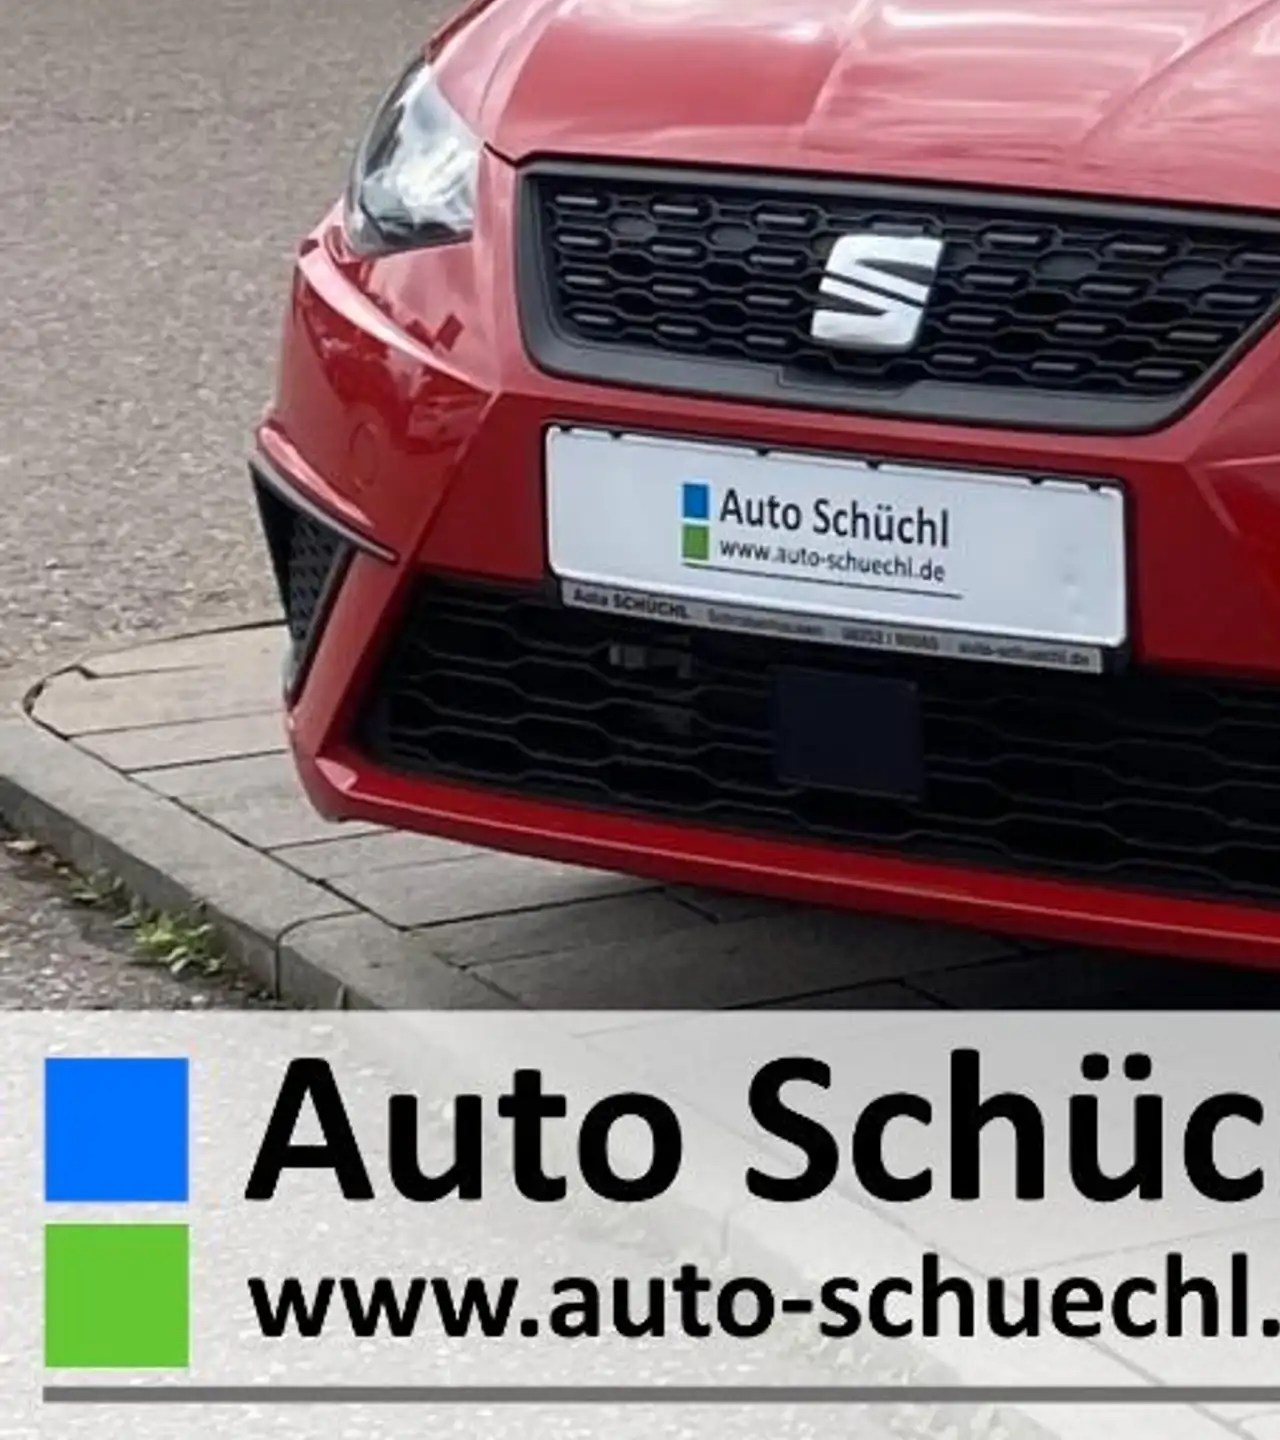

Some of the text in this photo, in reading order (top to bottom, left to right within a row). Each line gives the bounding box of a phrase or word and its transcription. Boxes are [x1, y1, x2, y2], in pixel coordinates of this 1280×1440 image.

[719, 488, 950, 548] Auto Schüchl
[719, 540, 946, 582] www.auto-schuechl.de
